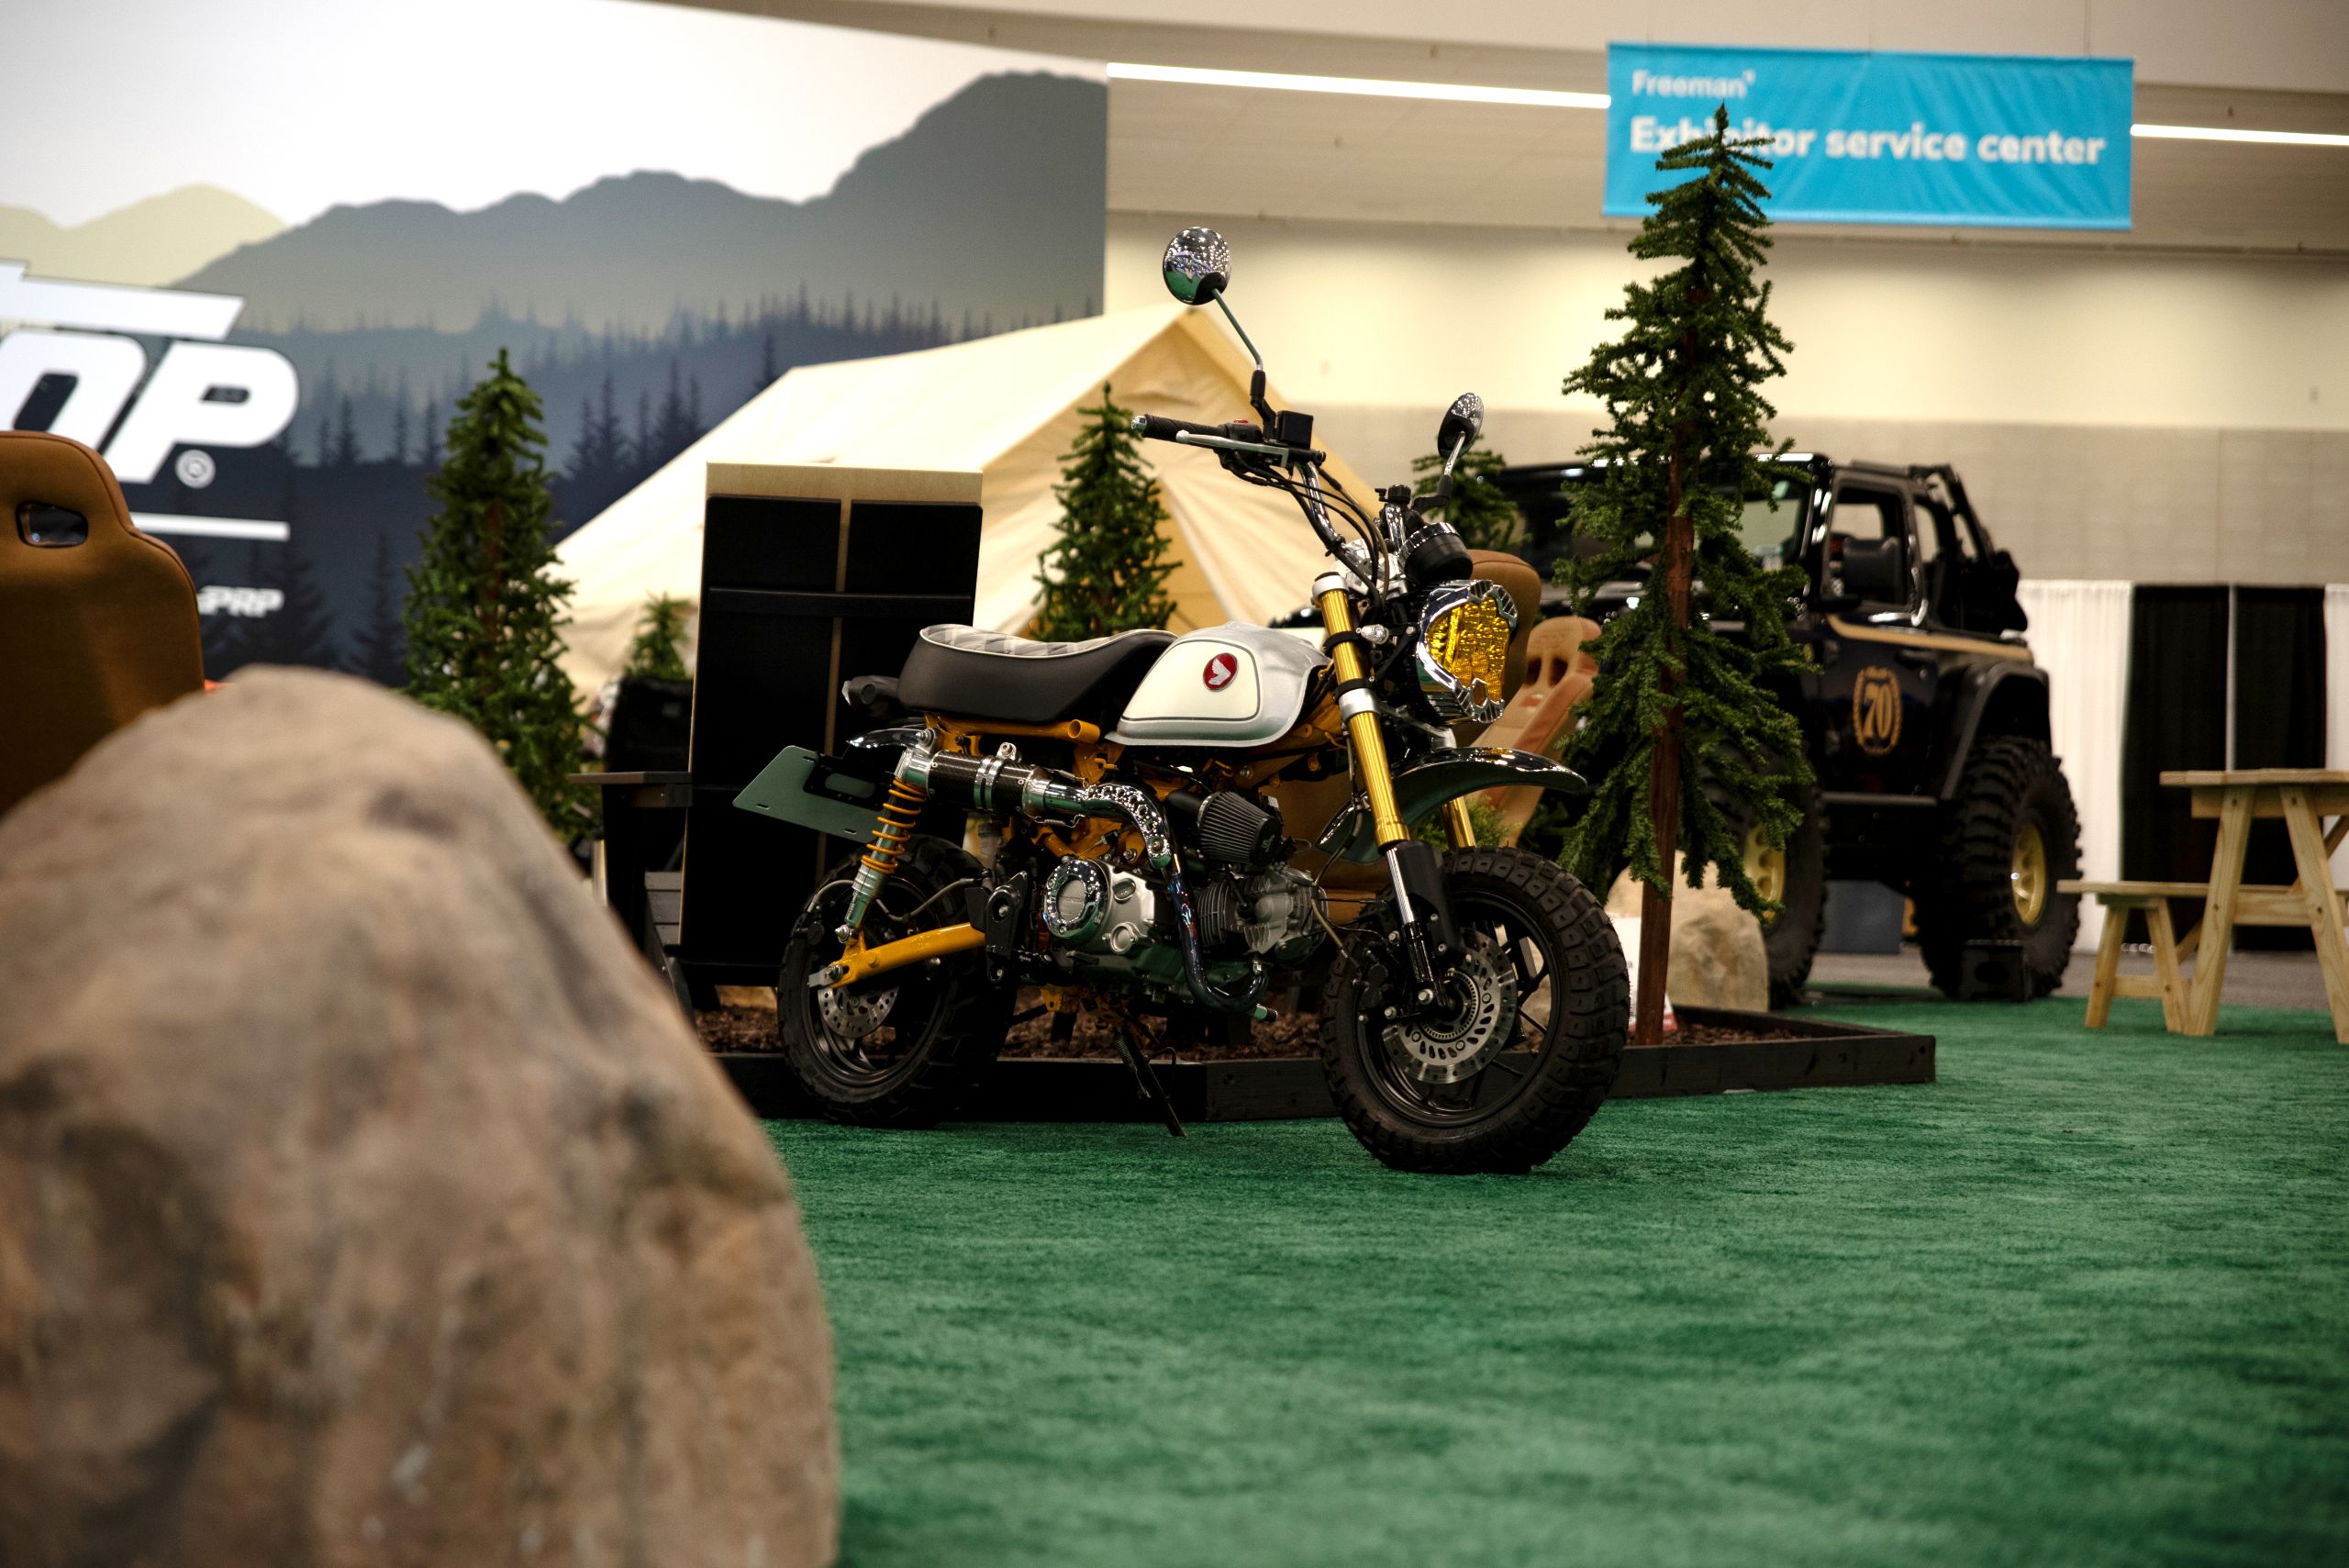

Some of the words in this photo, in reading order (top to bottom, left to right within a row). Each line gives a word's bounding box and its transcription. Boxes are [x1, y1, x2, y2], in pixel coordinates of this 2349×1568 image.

[1825, 122, 1967, 161] service
[1976, 130, 2108, 164] center
[0, 259, 299, 484] OP
[1864, 682, 1893, 740] 70
